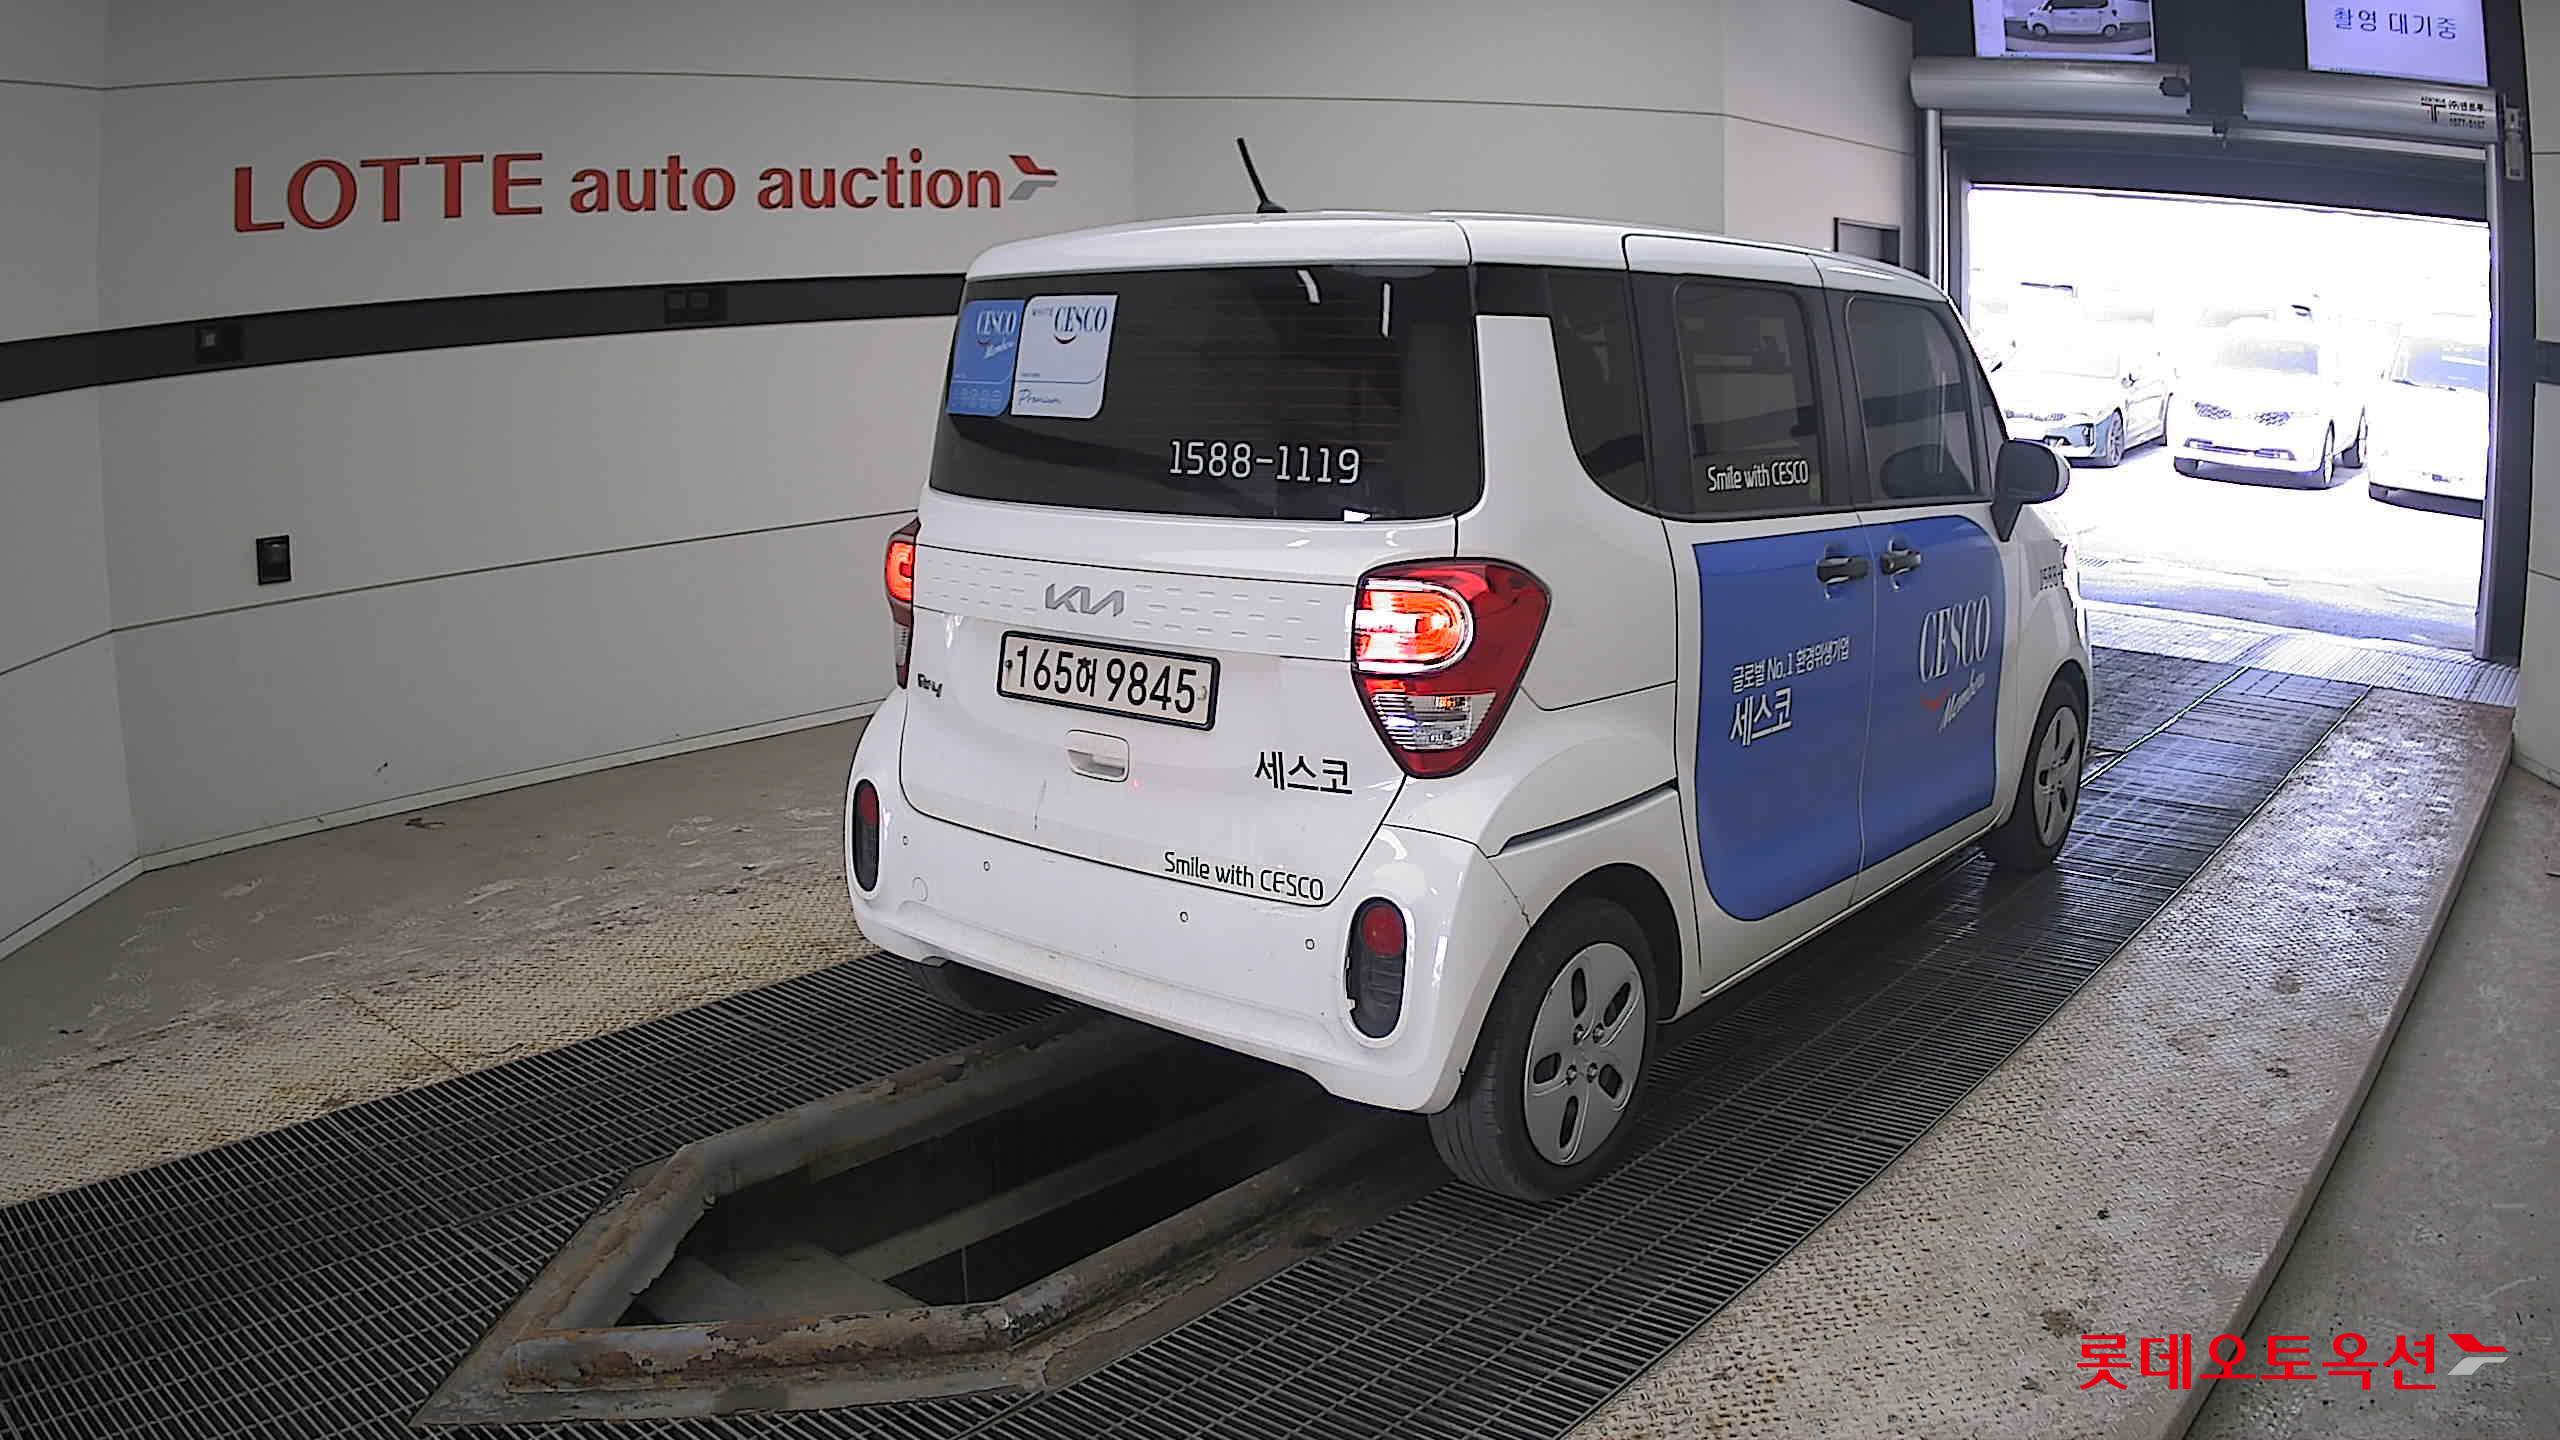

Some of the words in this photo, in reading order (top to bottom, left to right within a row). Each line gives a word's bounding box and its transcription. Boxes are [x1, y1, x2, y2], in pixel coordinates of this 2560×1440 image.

[2389, 12, 2457, 40] 대기중
[234, 152, 543, 233] LOTTE
[569, 154, 736, 213] auto
[759, 148, 1001, 212] auction
[976, 310, 1017, 336] CESCO
[1054, 305, 1107, 332] CESCO
[1169, 440, 1360, 484] 1588-1119
[1707, 465, 1742, 492] Smile
[1743, 463, 1770, 488] with
[1771, 460, 1809, 486] CESCO
[1046, 583, 1125, 618] KIA
[1920, 595, 1990, 683] CESCO
[1017, 644, 1097, 697] 165허
[1107, 657, 1198, 714] 9845
[1732, 659, 1766, 693] 글로벌
[1767, 652, 1793, 681] No.1
[1730, 687, 1792, 746] 세스코
[1254, 750, 1353, 795] 세스코
[1164, 851, 1210, 881] Smile
[1214, 864, 1255, 890] with
[1259, 873, 1324, 901] CESCO
